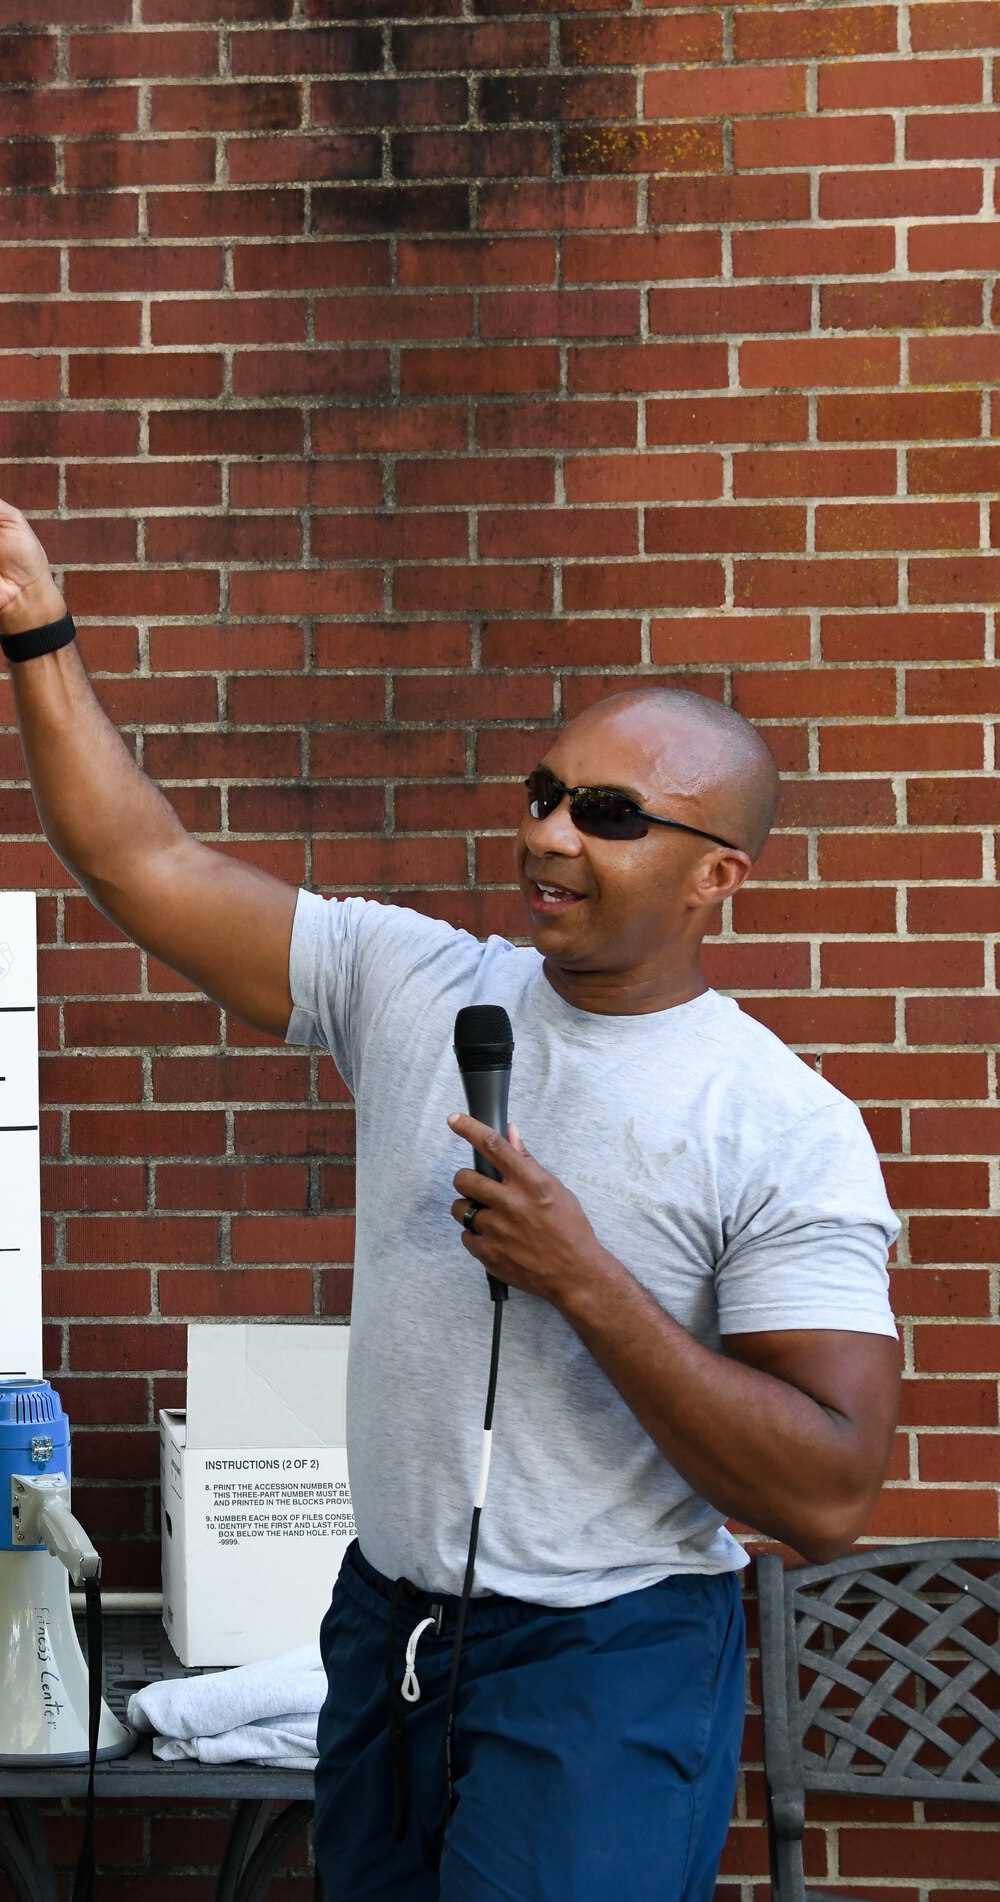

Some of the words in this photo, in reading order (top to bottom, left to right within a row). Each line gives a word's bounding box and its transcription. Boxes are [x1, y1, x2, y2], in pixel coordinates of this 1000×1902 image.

[205, 1460, 280, 1470] INSTRUCTIONS
[282, 1459, 292, 1471] (2
[293, 1459, 308, 1469] OF
[310, 1459, 319, 1470] 2)
